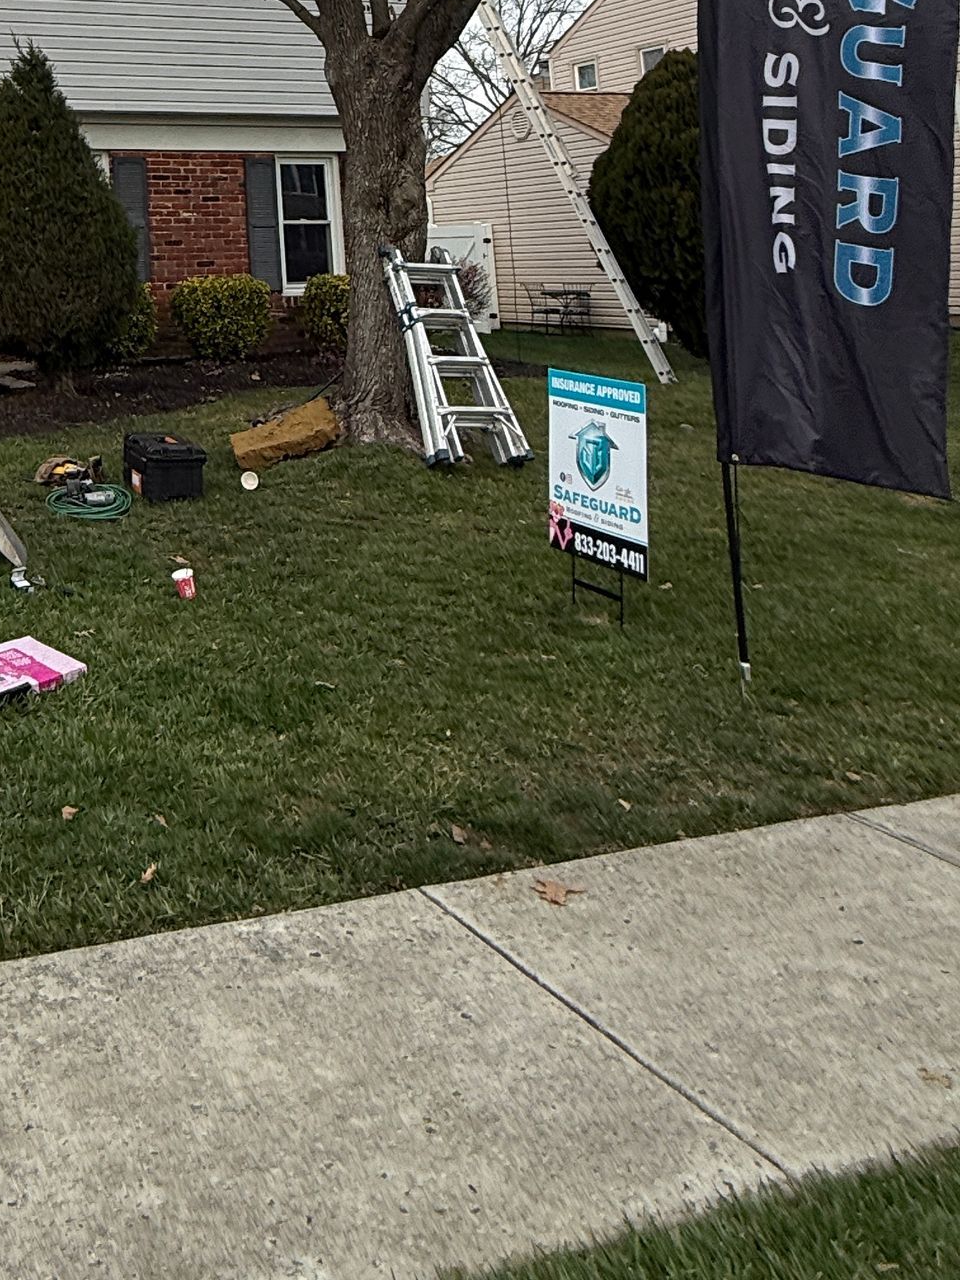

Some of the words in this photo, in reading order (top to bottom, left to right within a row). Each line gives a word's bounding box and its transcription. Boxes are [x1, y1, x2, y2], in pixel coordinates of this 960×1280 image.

[764, 51, 800, 276] SIDING
[552, 376, 596, 396] INSURANCE
[596, 385, 640, 404] APPROVED
[552, 400, 578, 410] ROOFING
[584, 406, 604, 416] SIDING
[610, 411, 640, 423] GUTTERS
[554, 484, 642, 524] SAFEGUARD
[574, 532, 644, 574] 833-203-4411
